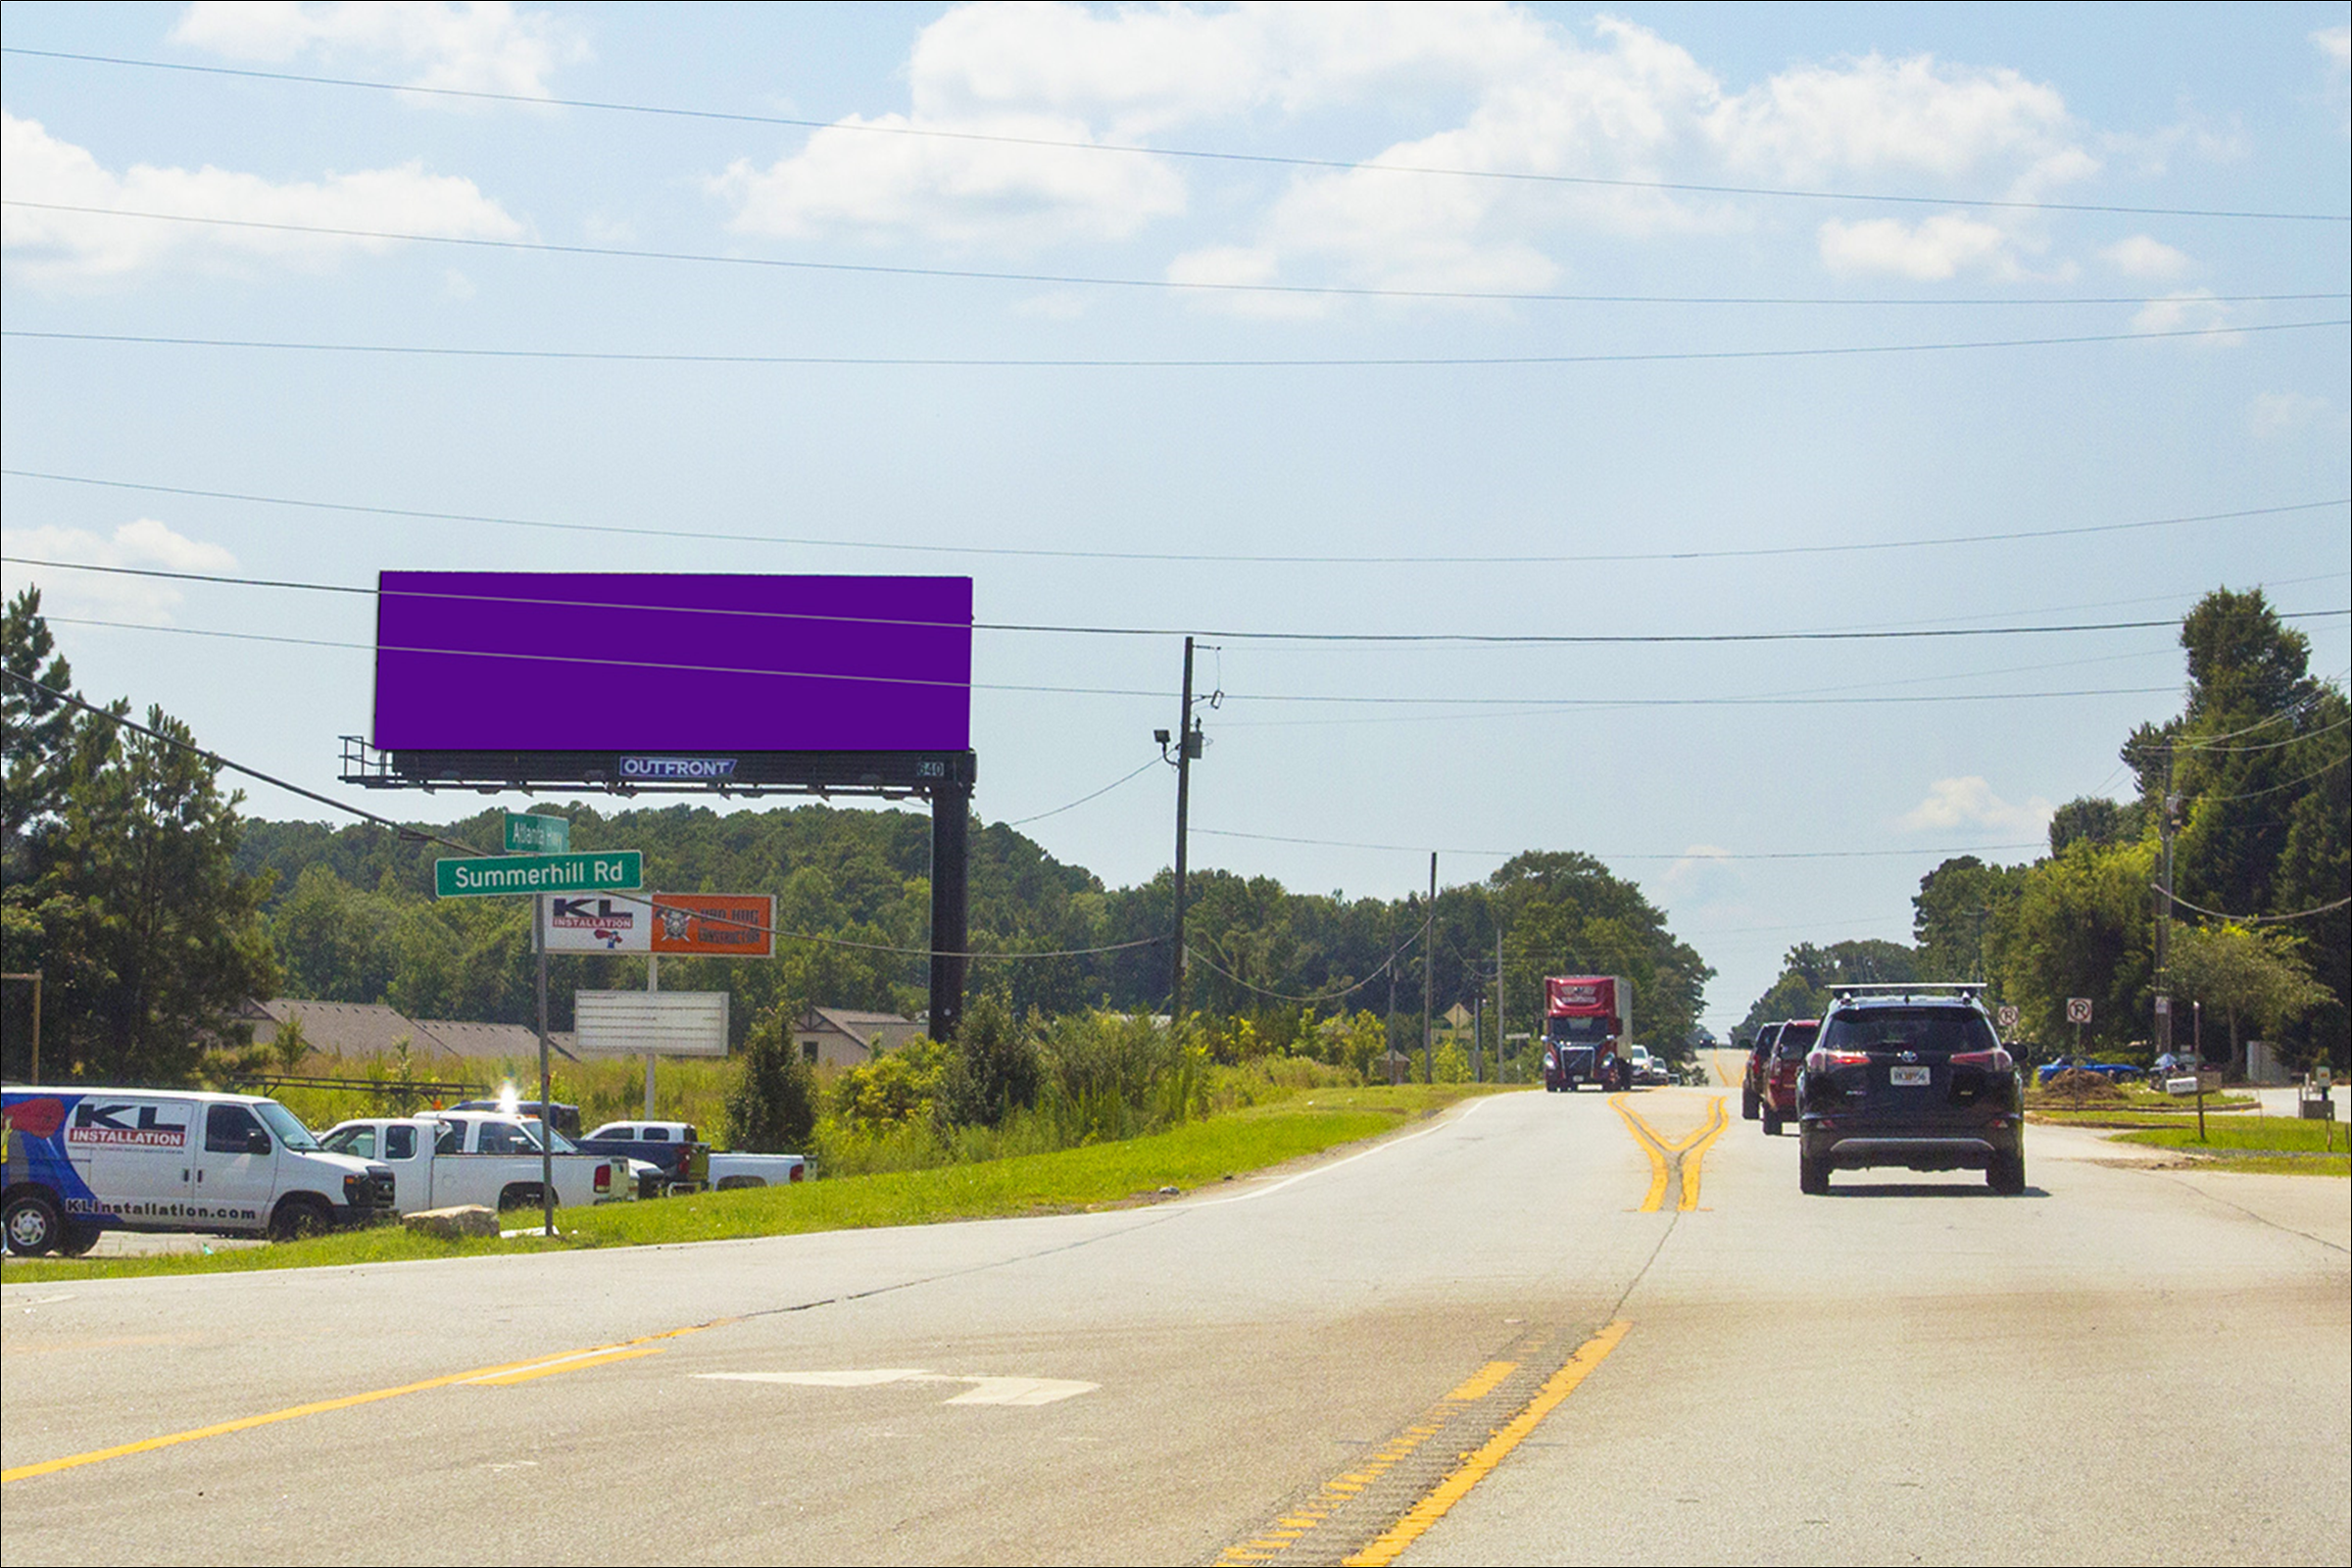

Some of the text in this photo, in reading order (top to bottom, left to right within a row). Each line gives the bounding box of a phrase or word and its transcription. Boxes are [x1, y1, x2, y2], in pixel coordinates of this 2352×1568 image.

[624, 759, 729, 775] OUTFRONT
[916, 761, 945, 776] 640
[513, 821, 544, 846] Atlanta
[455, 859, 623, 889] Summerhill Rd
[553, 898, 633, 918] KL
[554, 917, 632, 928] INSTALLATION
[74, 1103, 186, 1132] KL
[72, 1129, 182, 1146] INSTALLATION
[66, 1199, 256, 1220] KLInstallation.com
